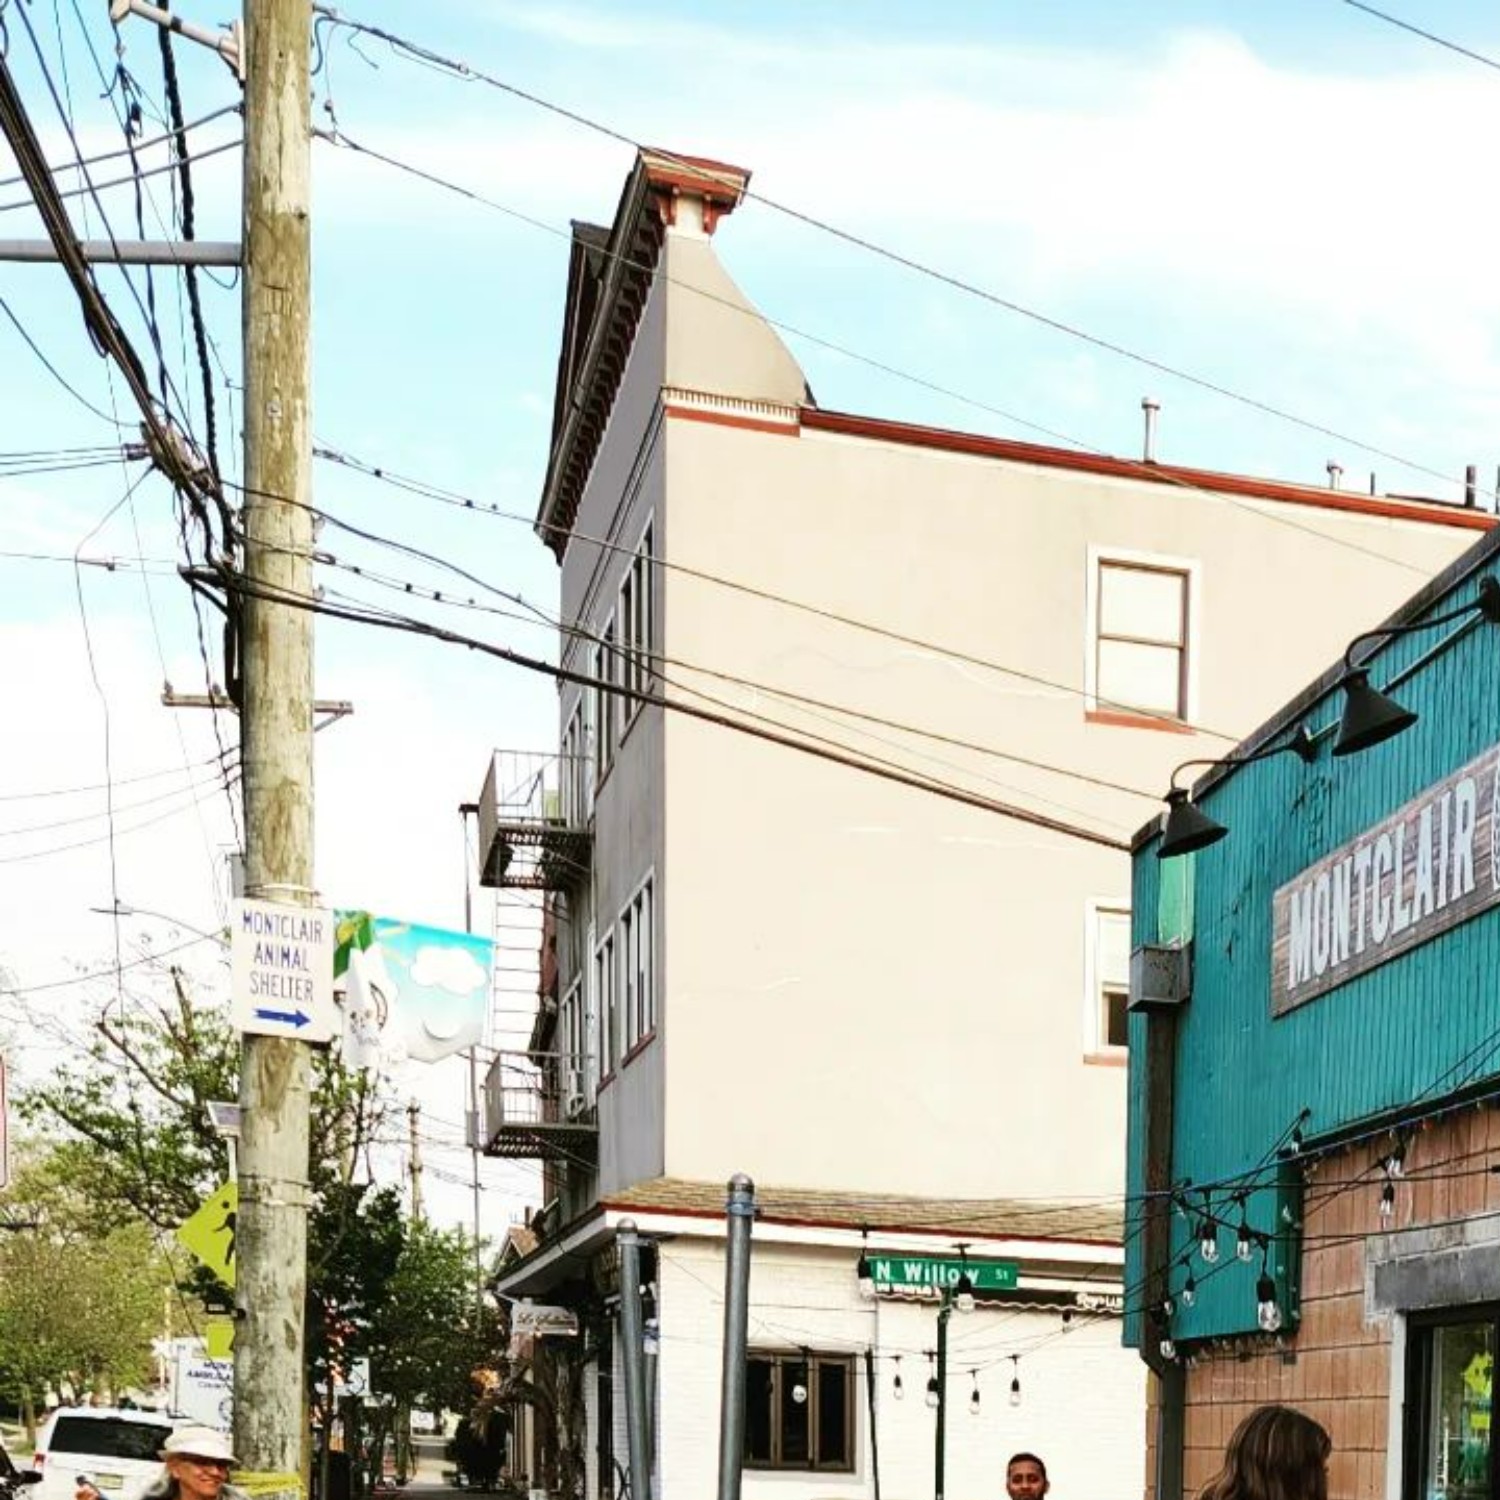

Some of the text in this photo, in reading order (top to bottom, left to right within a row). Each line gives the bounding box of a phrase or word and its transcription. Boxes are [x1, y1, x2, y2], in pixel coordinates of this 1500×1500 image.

[1286, 777, 1477, 990] MONTCLAIR
[243, 910, 322, 943] MONTCLAIR
[254, 943, 309, 970] ANIMAL
[250, 970, 313, 1001] SHELTER
[877, 1261, 1009, 1284] N Willow St
